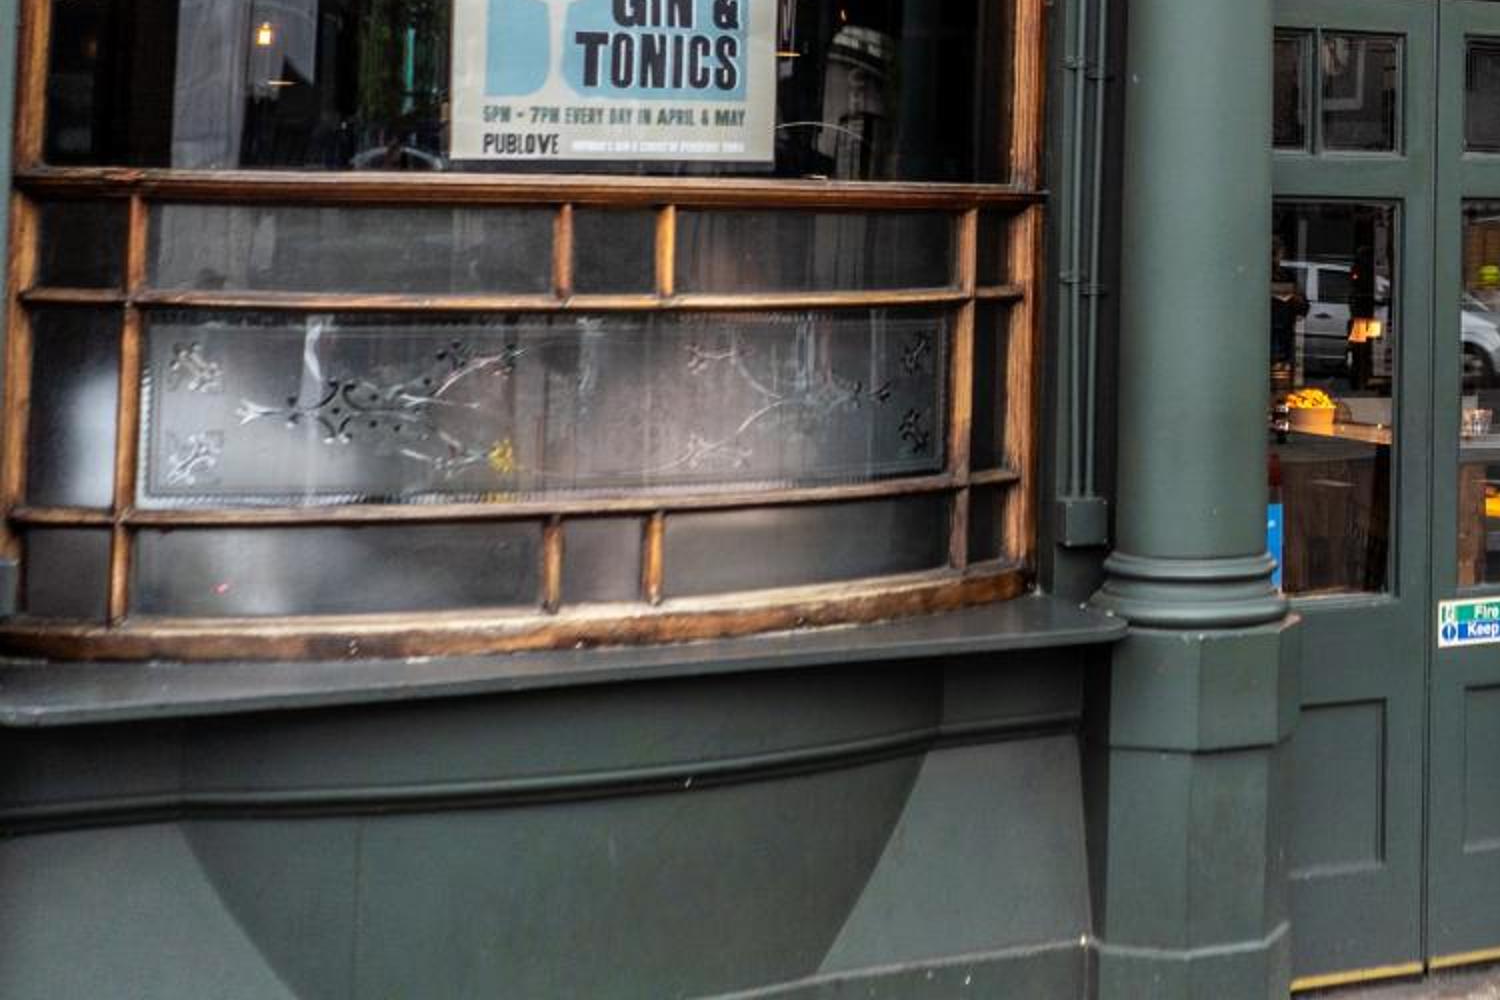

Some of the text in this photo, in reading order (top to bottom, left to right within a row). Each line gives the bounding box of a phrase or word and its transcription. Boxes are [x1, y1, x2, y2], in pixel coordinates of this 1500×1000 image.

[575, 31, 740, 91] TONICS
[530, 106, 559, 124] 7PM
[564, 107, 604, 125] EVERY
[609, 107, 632, 125] DAY
[637, 108, 651, 125] IN
[656, 108, 694, 126] APRIL
[715, 109, 746, 127] MAY
[482, 133, 560, 154] PUBLOVE
[1474, 604, 1500, 619] Fire
[1468, 620, 1500, 638] Keep
